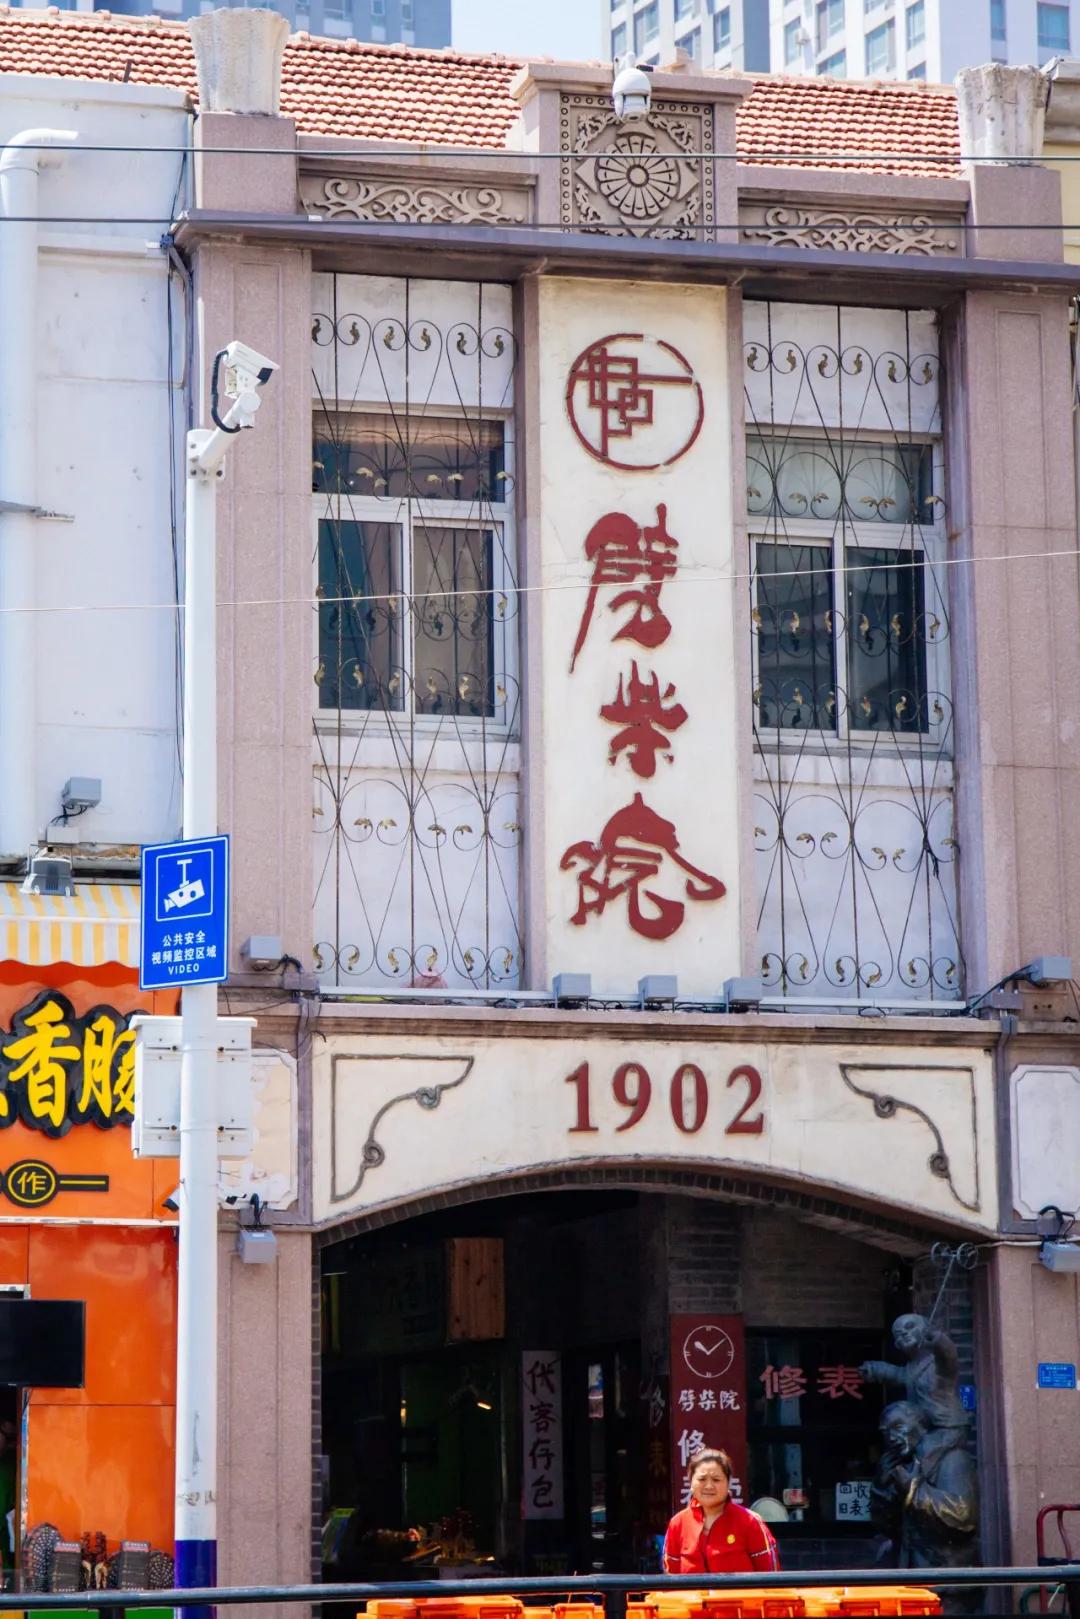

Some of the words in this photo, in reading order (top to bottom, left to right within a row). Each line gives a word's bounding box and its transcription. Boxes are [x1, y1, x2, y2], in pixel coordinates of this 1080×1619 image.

[162, 929, 206, 947] 公共安全
[151, 944, 217, 965] 视频监控区域
[168, 962, 200, 975] VIDEO
[565, 1060, 764, 1134] 1902
[17, 1171, 47, 1195] 作
[760, 1365, 864, 1400] 修表
[678, 1388, 740, 1412] 劈柴院
[840, 1482, 869, 1499] 回收
